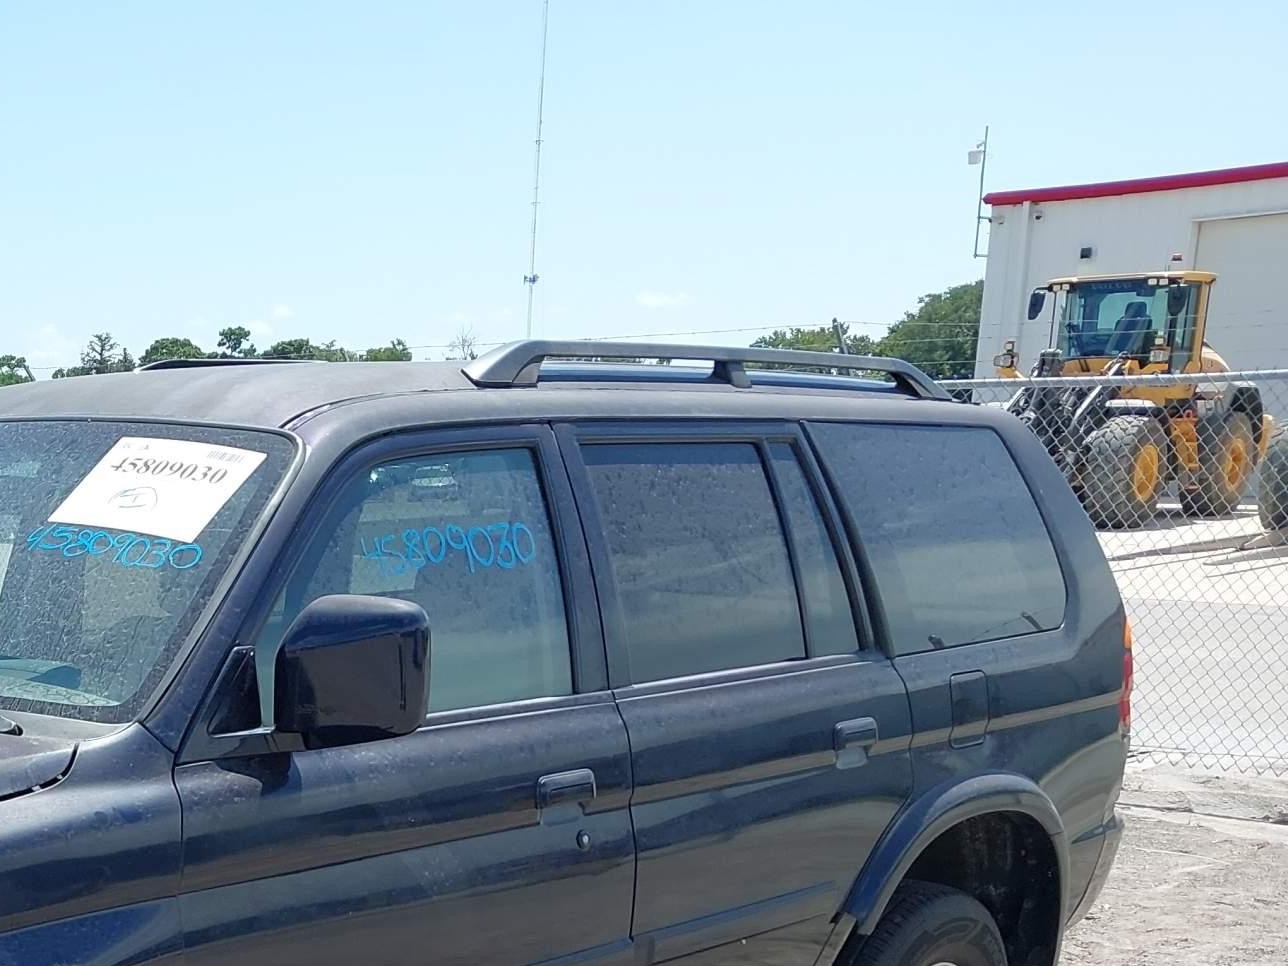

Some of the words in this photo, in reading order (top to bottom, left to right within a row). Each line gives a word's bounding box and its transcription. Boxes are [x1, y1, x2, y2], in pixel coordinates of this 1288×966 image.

[110, 456, 229, 485] 45809030
[26, 522, 203, 570] 45809030
[360, 521, 537, 577] 45809030
